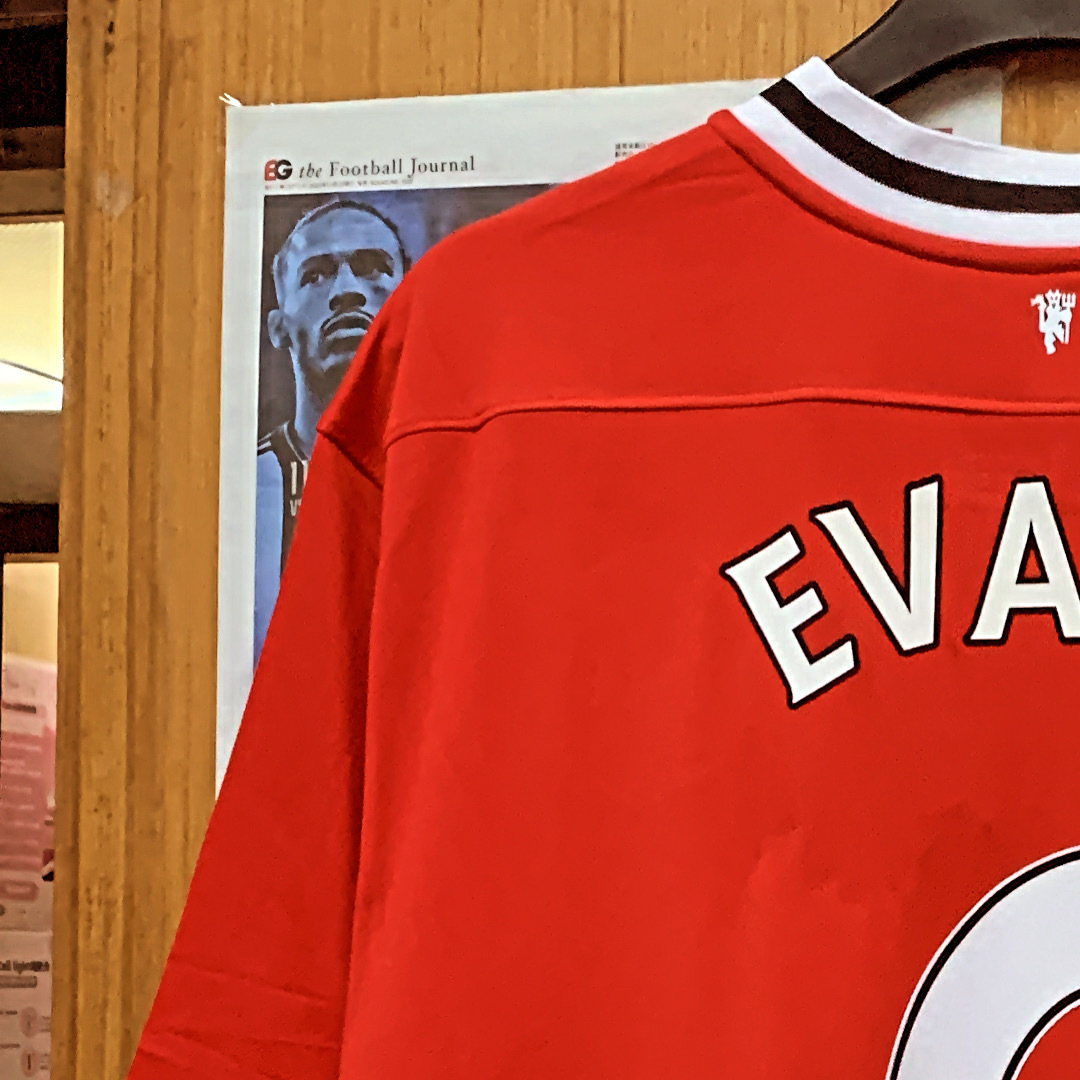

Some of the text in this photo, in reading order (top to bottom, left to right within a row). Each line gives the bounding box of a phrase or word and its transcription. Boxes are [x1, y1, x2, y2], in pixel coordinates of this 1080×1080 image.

[299, 162, 322, 178] the
[329, 158, 402, 177] Football
[407, 155, 475, 179] Journal
